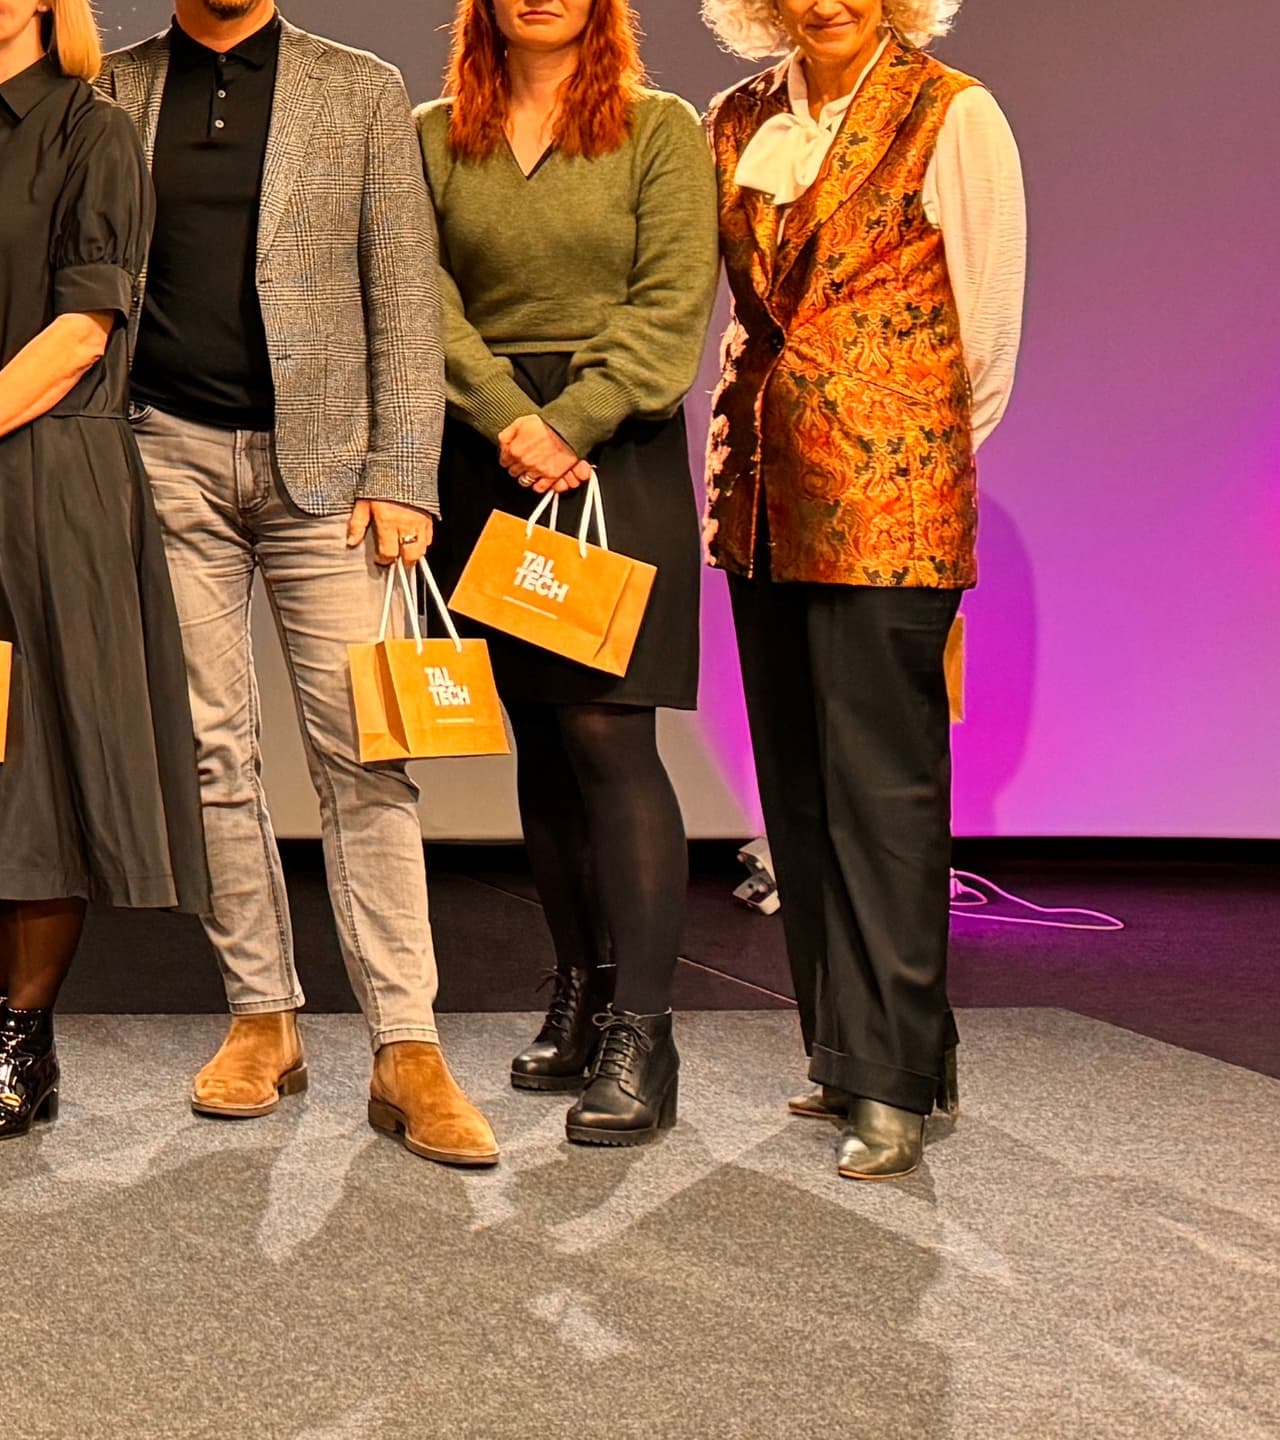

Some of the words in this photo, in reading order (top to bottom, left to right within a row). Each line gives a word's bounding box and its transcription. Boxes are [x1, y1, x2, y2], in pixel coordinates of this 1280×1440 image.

[522, 550, 556, 578] TAL
[512, 566, 570, 603] TECH
[424, 667, 454, 687] TAL
[428, 684, 471, 707] TECH
